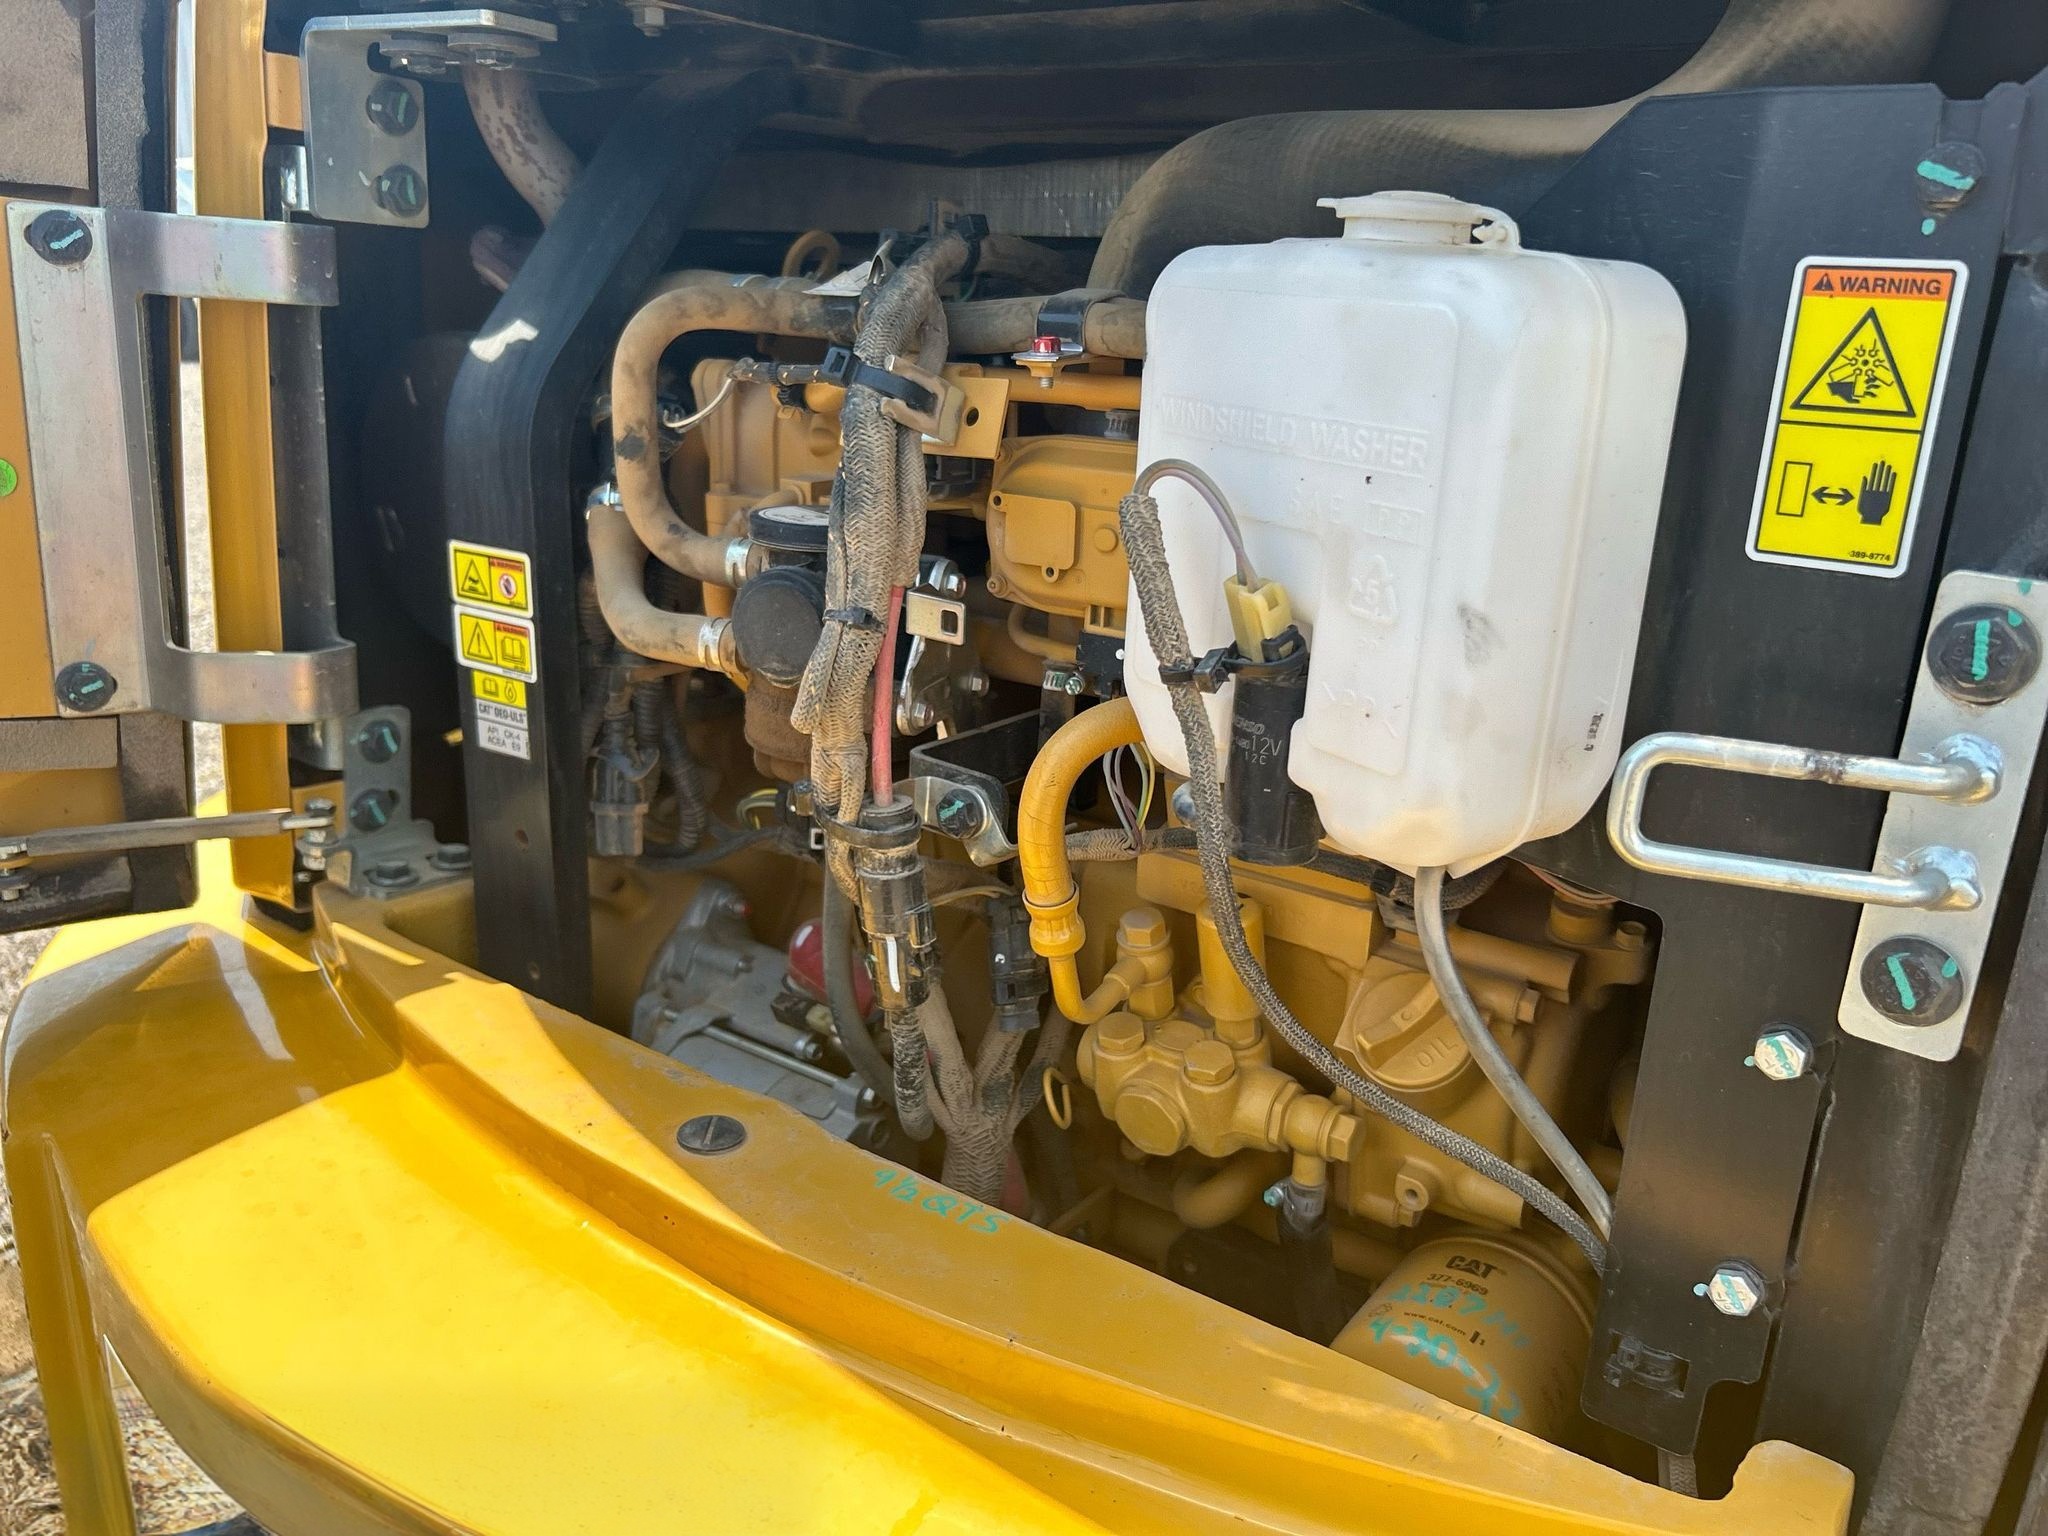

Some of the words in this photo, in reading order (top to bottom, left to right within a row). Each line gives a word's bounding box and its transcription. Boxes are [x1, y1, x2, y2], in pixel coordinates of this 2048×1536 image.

[1840, 276, 1942, 295] WARNING
[1161, 395, 1299, 447] WINDSHIELD
[1311, 420, 1429, 471] WASHER
[1848, 550, 1891, 561] 389-8774
[1252, 735, 1282, 756] 12V
[1417, 1036, 1459, 1067] OIL
[1445, 1255, 1498, 1279] CAT
[1427, 1273, 1489, 1296] 377-6969
[1403, 1311, 1467, 1337] www.cat.com
